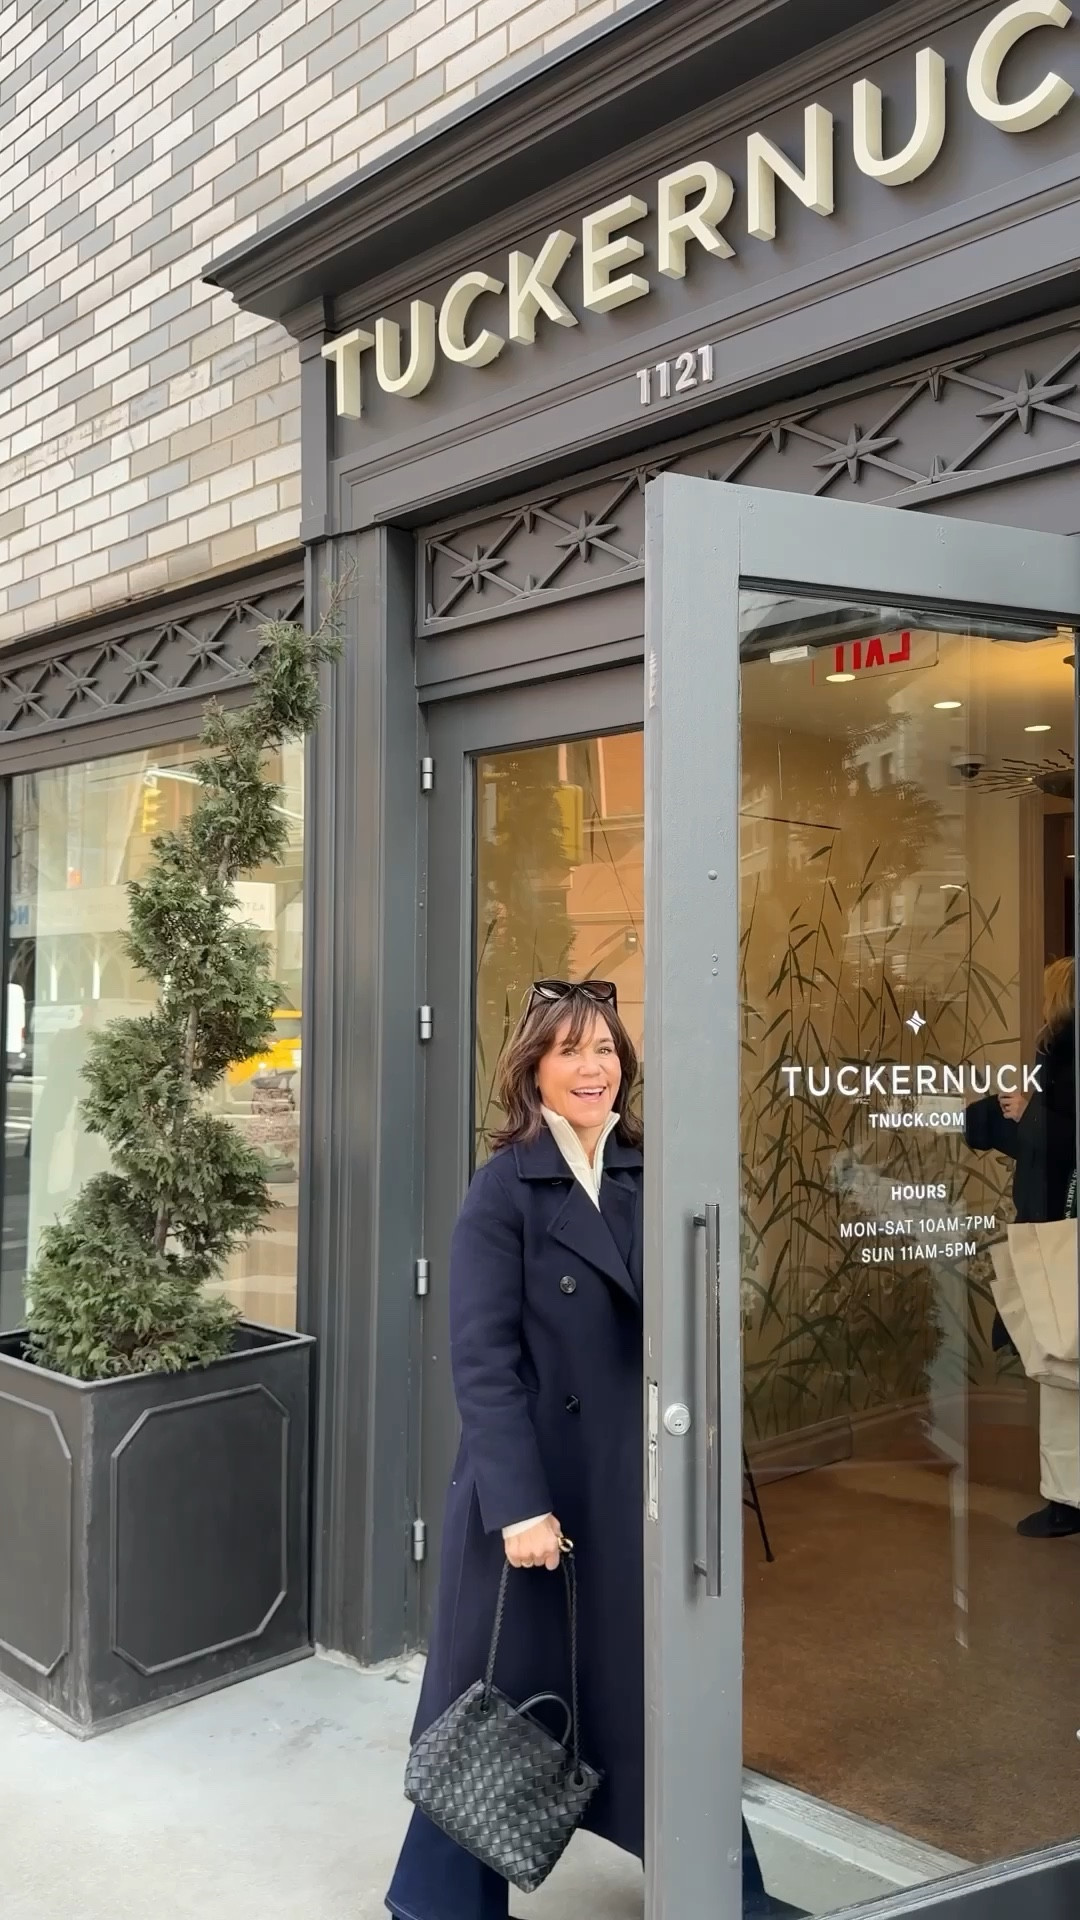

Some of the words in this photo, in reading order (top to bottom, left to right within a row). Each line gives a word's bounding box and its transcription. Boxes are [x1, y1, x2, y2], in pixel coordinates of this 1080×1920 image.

[321, 0, 1074, 419] TUCKERNUC
[637, 345, 713, 405] 1121
[781, 1064, 1043, 1097] TUCKERNUCK
[869, 1112, 965, 1128] TNUCK.COM
[891, 1184, 946, 1200] HOURS
[840, 1219, 913, 1238] MON-SAT
[919, 1215, 995, 1233] 10AM-7PM
[861, 1247, 894, 1263] SUN
[900, 1241, 976, 1260] 11AM-5PM
